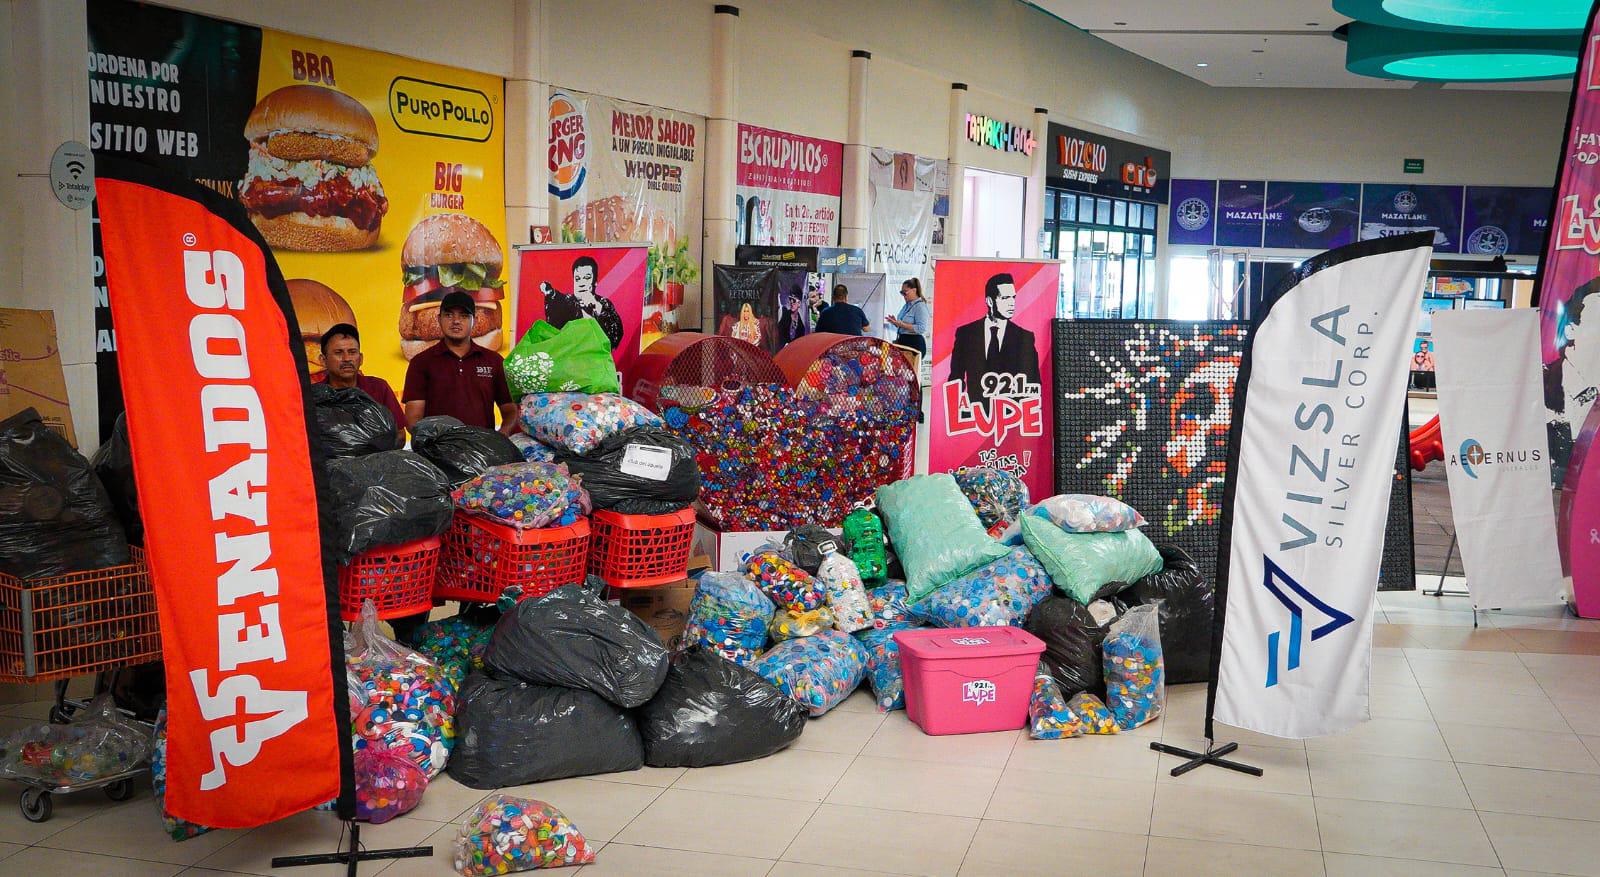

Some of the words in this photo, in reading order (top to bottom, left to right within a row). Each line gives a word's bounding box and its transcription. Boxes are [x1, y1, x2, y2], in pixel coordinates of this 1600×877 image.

[88, 52, 148, 79] ORDENA
[152, 61, 180, 84] POR
[291, 50, 336, 87] BBQ
[90, 79, 181, 113] NUESTRO
[90, 122, 147, 153] SITIO
[157, 129, 199, 158] WEB
[612, 110, 654, 140] MEJOR
[657, 118, 696, 148] SABOR
[619, 139, 630, 154] UN
[740, 130, 822, 174] ESCRUPULOS
[434, 161, 463, 192] BIG
[624, 159, 682, 183] WHOPPER
[430, 193, 464, 210] BURGER
[1024, 386, 1039, 394] FM
[1280, 305, 1351, 552] VIZSLA
[1325, 433, 1361, 548] SILVER
[1346, 310, 1380, 409] CORP.
[979, 448, 997, 462] TUS
[184, 250, 308, 790] VENADOS
